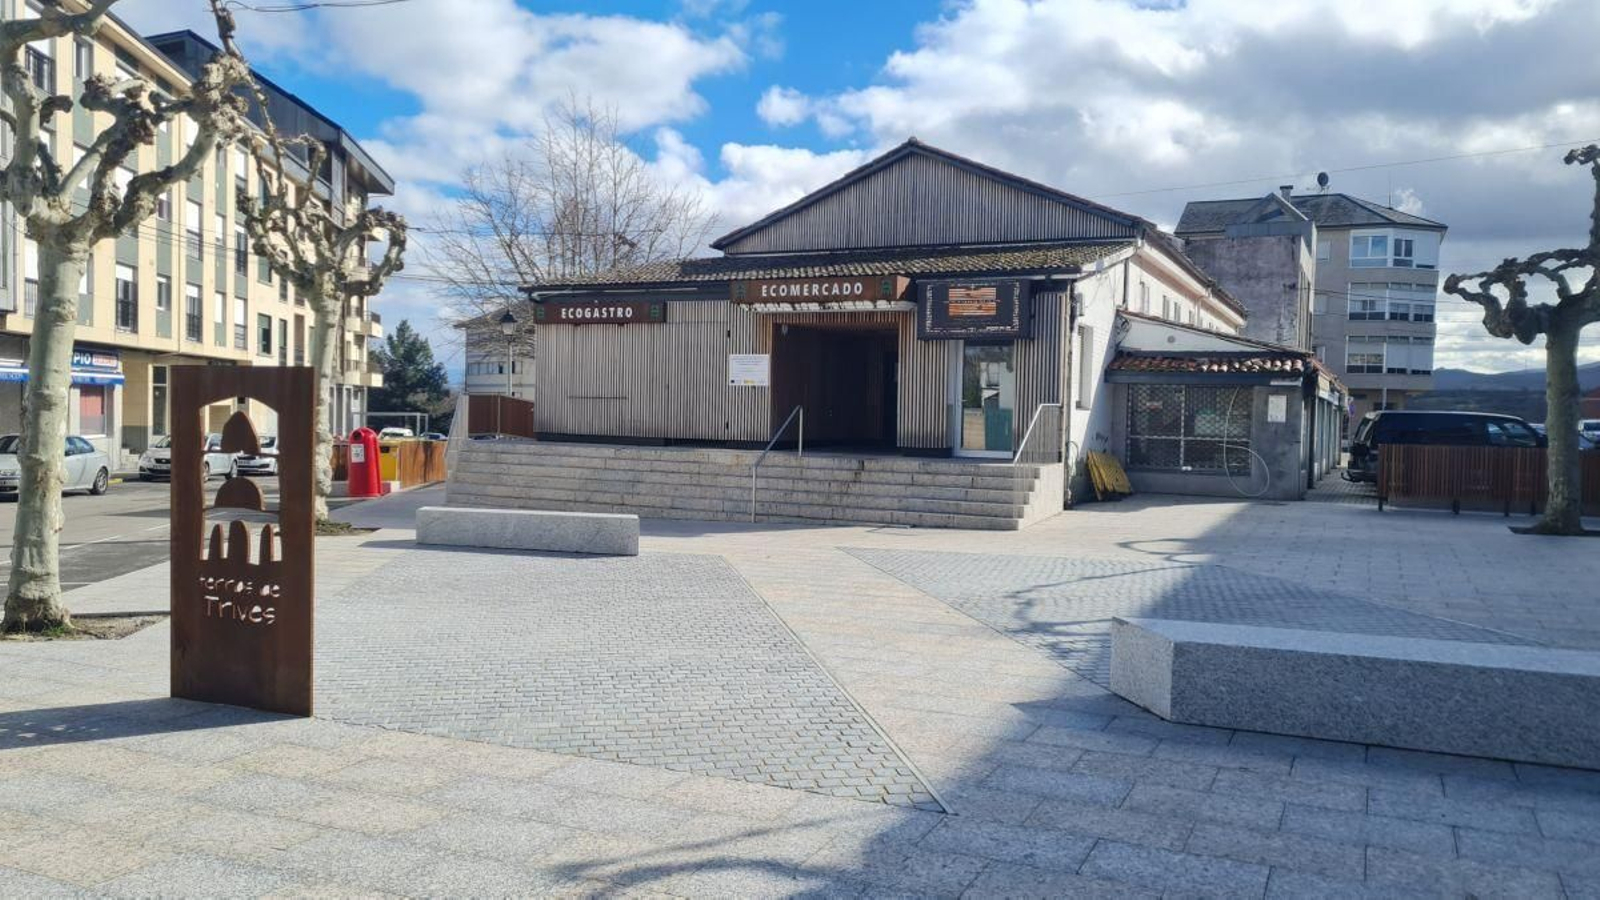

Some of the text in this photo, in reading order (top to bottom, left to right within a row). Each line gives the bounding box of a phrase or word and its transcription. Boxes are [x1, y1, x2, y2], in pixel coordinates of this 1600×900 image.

[761, 282, 864, 297] ECOMERCADO
[560, 307, 633, 319] ECOGASTRO
[203, 595, 276, 625] Trives
